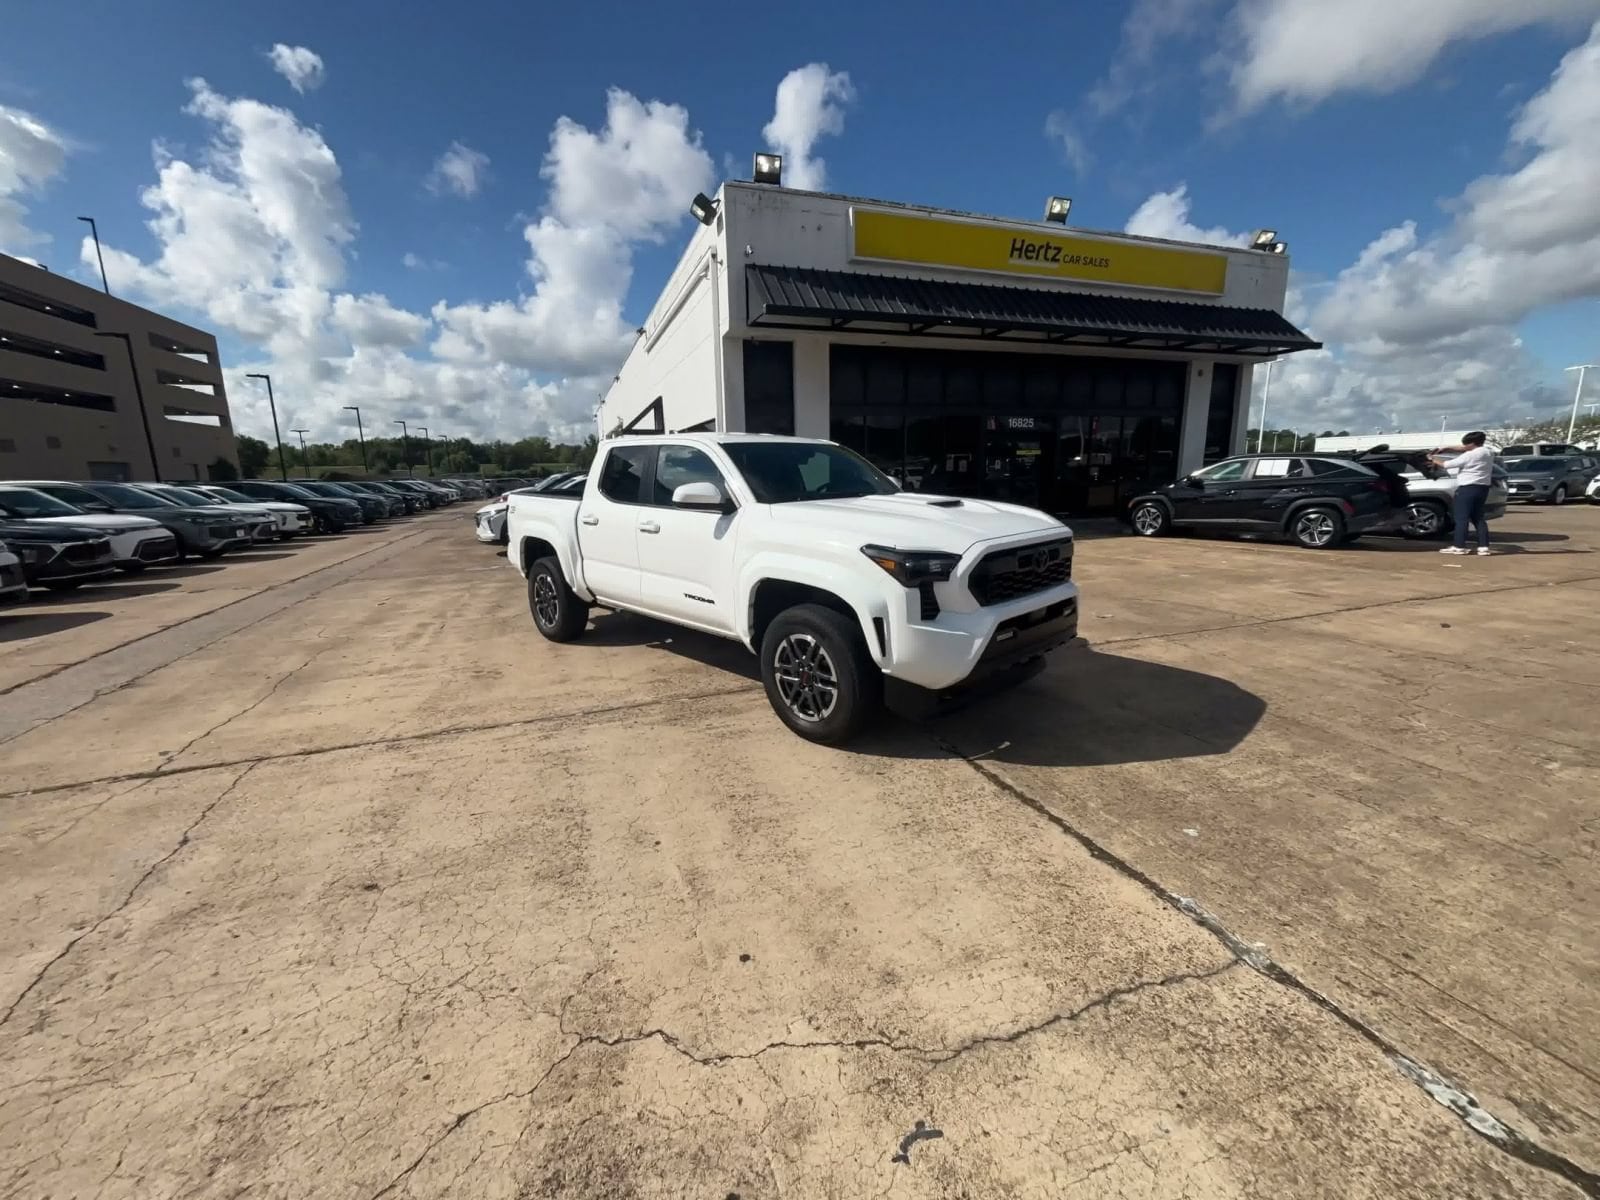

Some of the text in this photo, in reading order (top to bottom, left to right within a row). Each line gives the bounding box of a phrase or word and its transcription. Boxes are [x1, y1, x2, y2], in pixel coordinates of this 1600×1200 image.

[1009, 238, 1111, 268] Hertz CAR SALES
[1008, 417, 1034, 429] 16825
